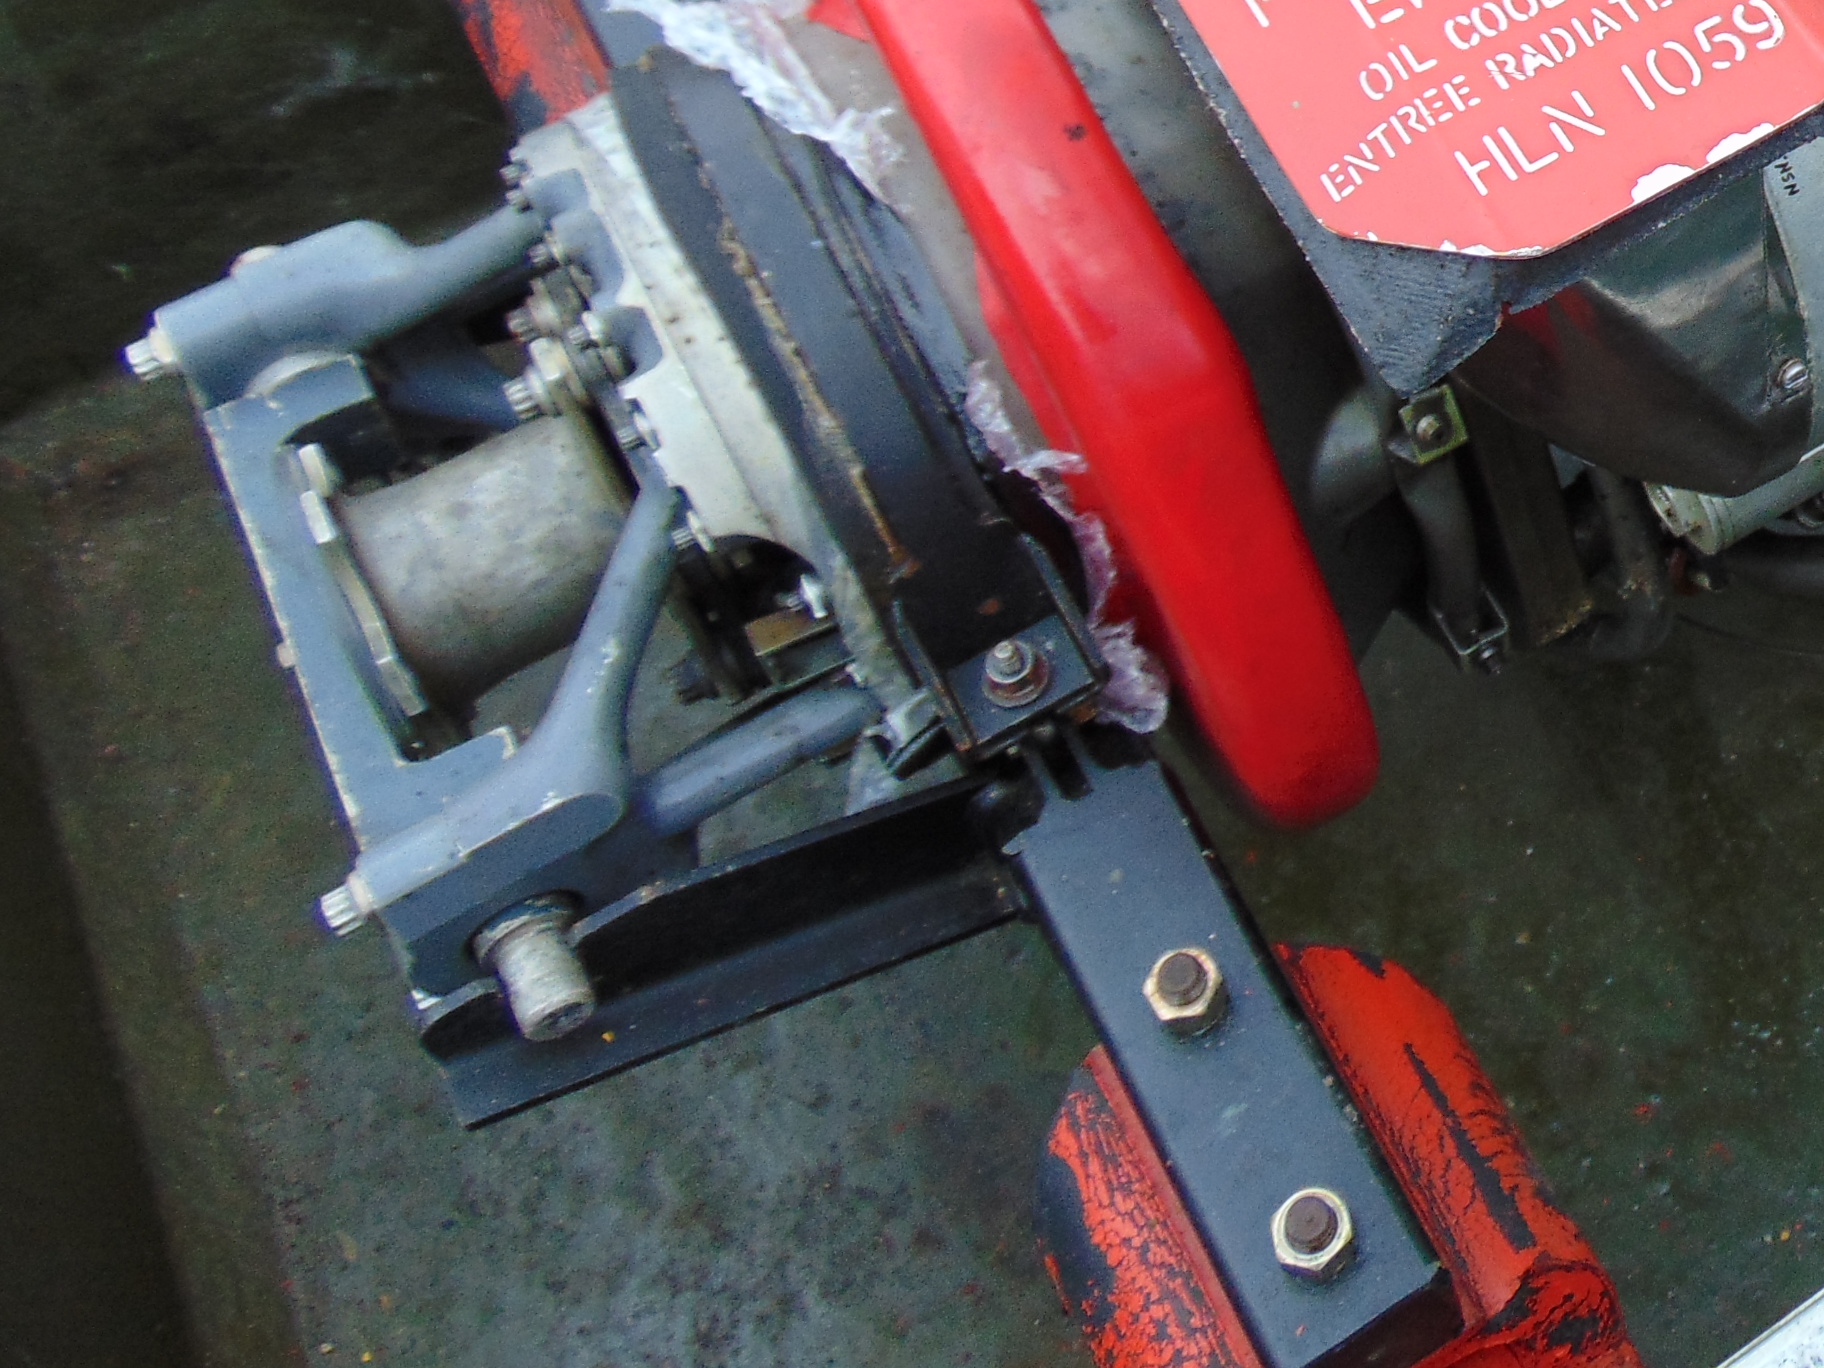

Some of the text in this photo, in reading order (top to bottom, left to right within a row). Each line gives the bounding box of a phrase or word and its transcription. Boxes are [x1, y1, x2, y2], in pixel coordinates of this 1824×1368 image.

[1360, 44, 1438, 101] OIL
[1320, 75, 1481, 202] ENTREE
[1454, 90, 1607, 196] HLN
